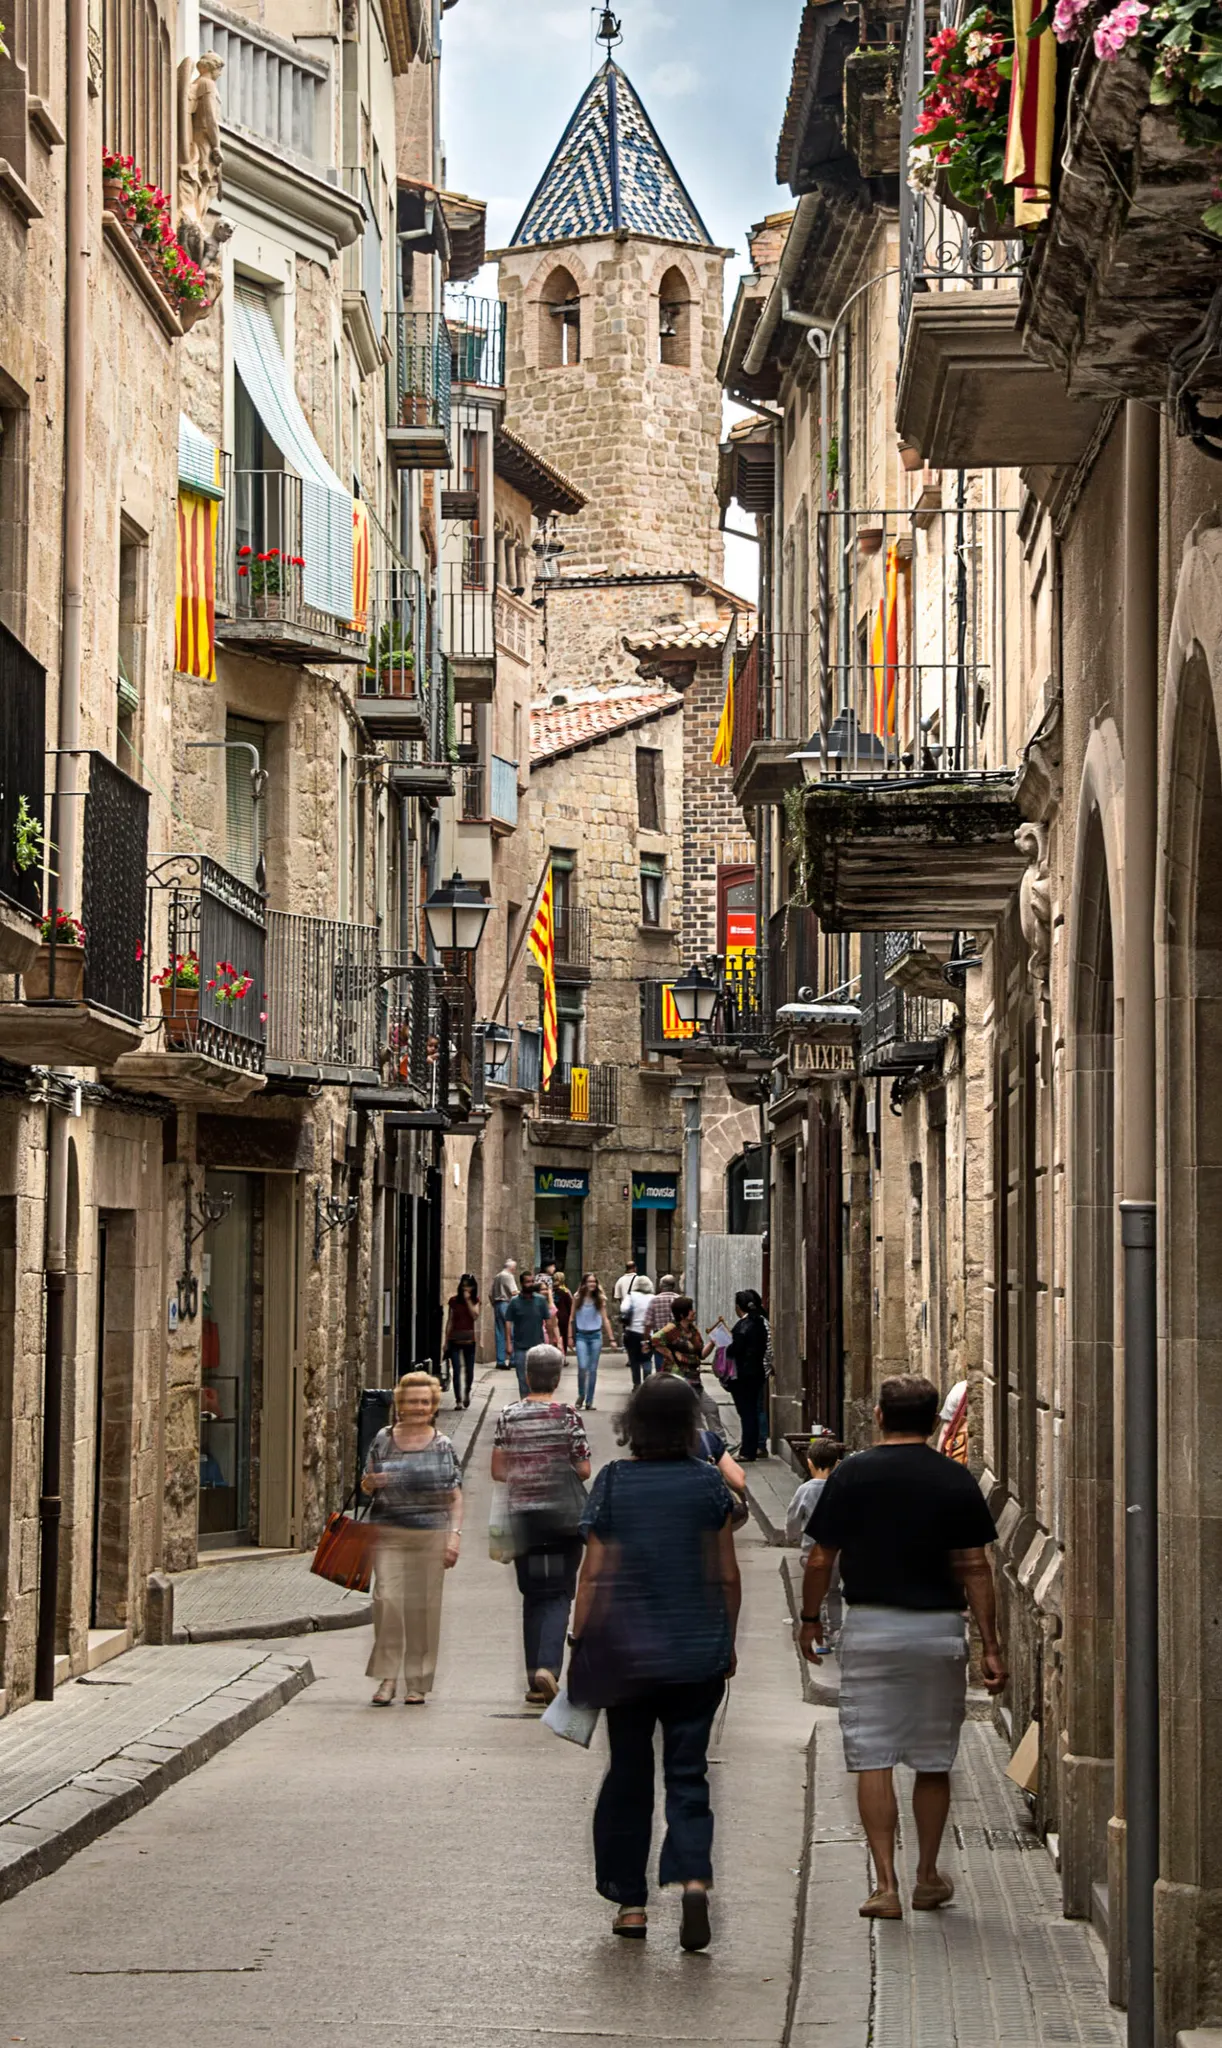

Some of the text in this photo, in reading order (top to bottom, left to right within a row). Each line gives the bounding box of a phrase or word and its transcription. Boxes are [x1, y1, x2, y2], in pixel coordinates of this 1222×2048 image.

[794, 1043, 855, 1070] L'AIXETA
[553, 1177, 585, 1189] movistar
[646, 1186, 676, 1198] movistar
